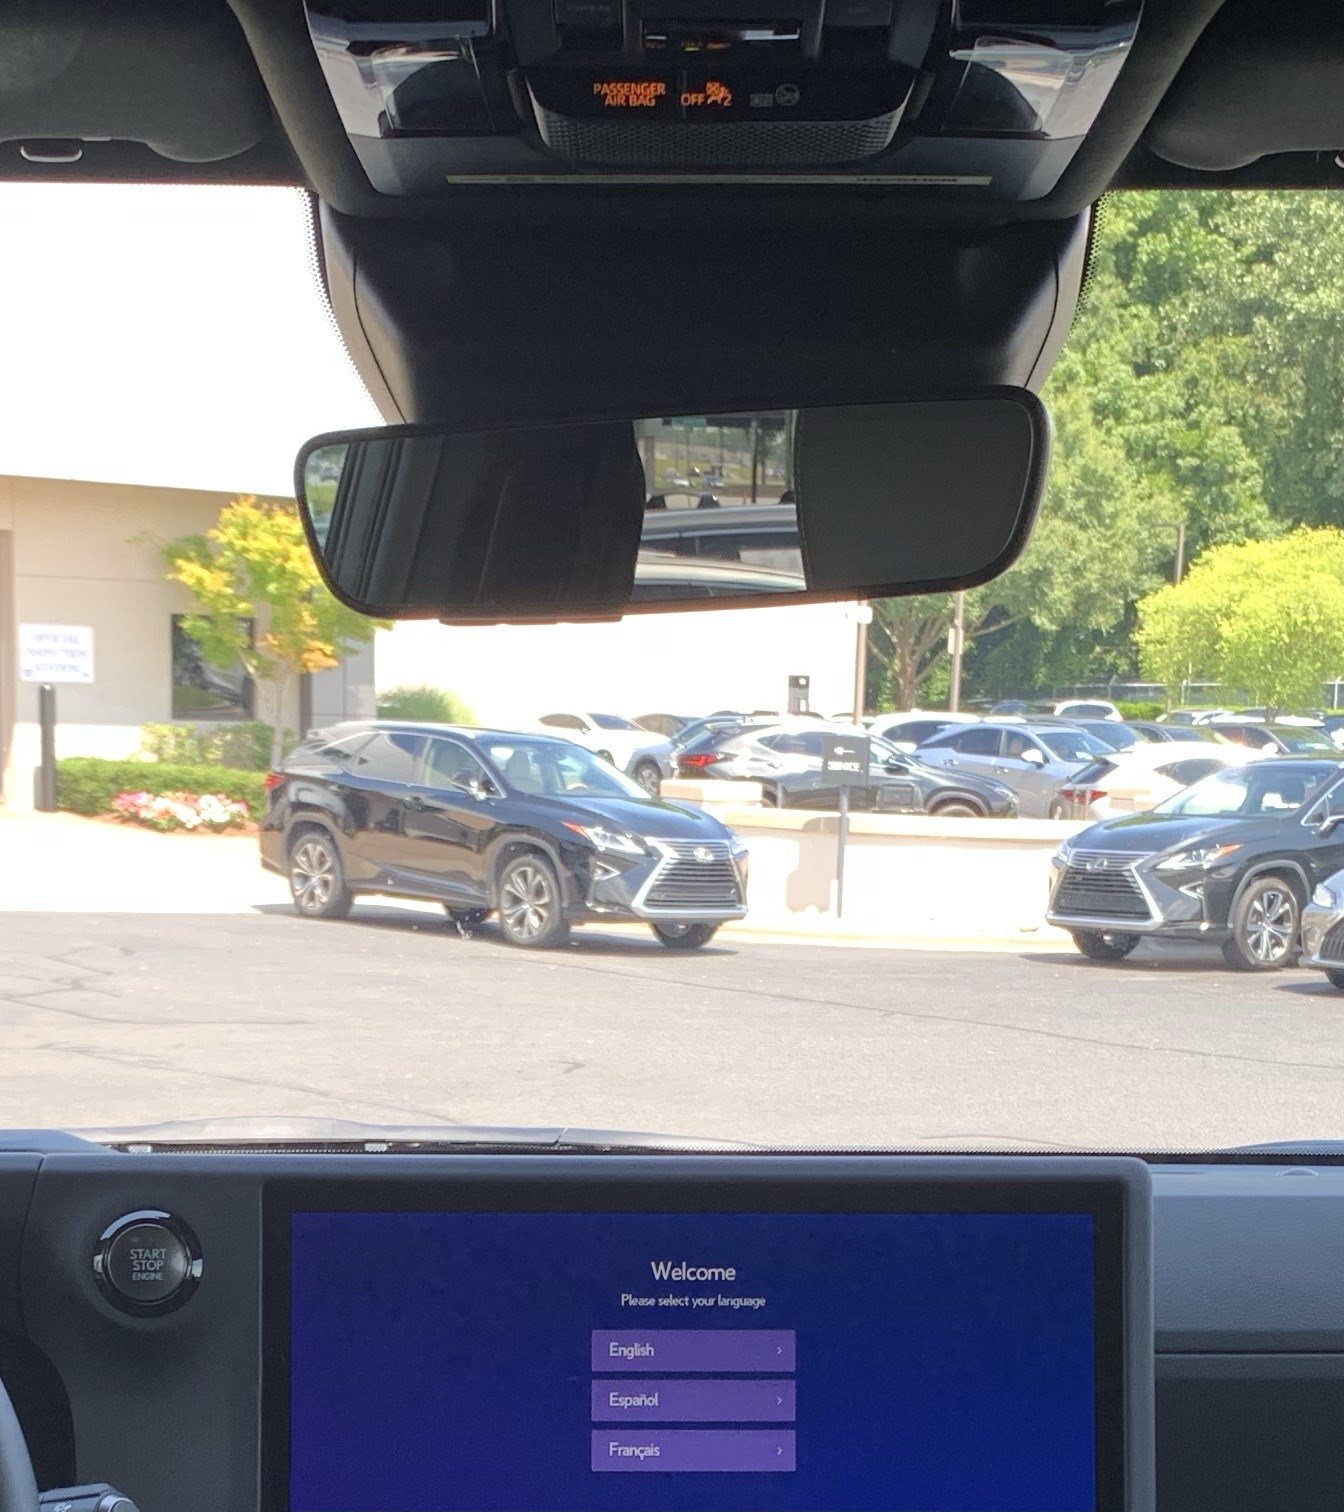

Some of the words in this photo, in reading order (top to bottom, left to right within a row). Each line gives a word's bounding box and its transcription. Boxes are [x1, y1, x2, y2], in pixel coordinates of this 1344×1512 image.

[592, 83, 666, 96] PASSENGER
[605, 95, 627, 107] AIR
[629, 95, 656, 107] BAG
[680, 93, 705, 106] OFF
[130, 1249, 167, 1260] START
[132, 1260, 164, 1270] STOP
[650, 1260, 737, 1282] Welcome
[132, 1272, 164, 1281] ENGINE
[620, 1293, 655, 1307] Please
[658, 1294, 689, 1307] select
[691, 1296, 714, 1310] your
[717, 1293, 766, 1310] language
[608, 1342, 655, 1360] English
[608, 1392, 660, 1410] Español
[608, 1442, 661, 1461] Français
